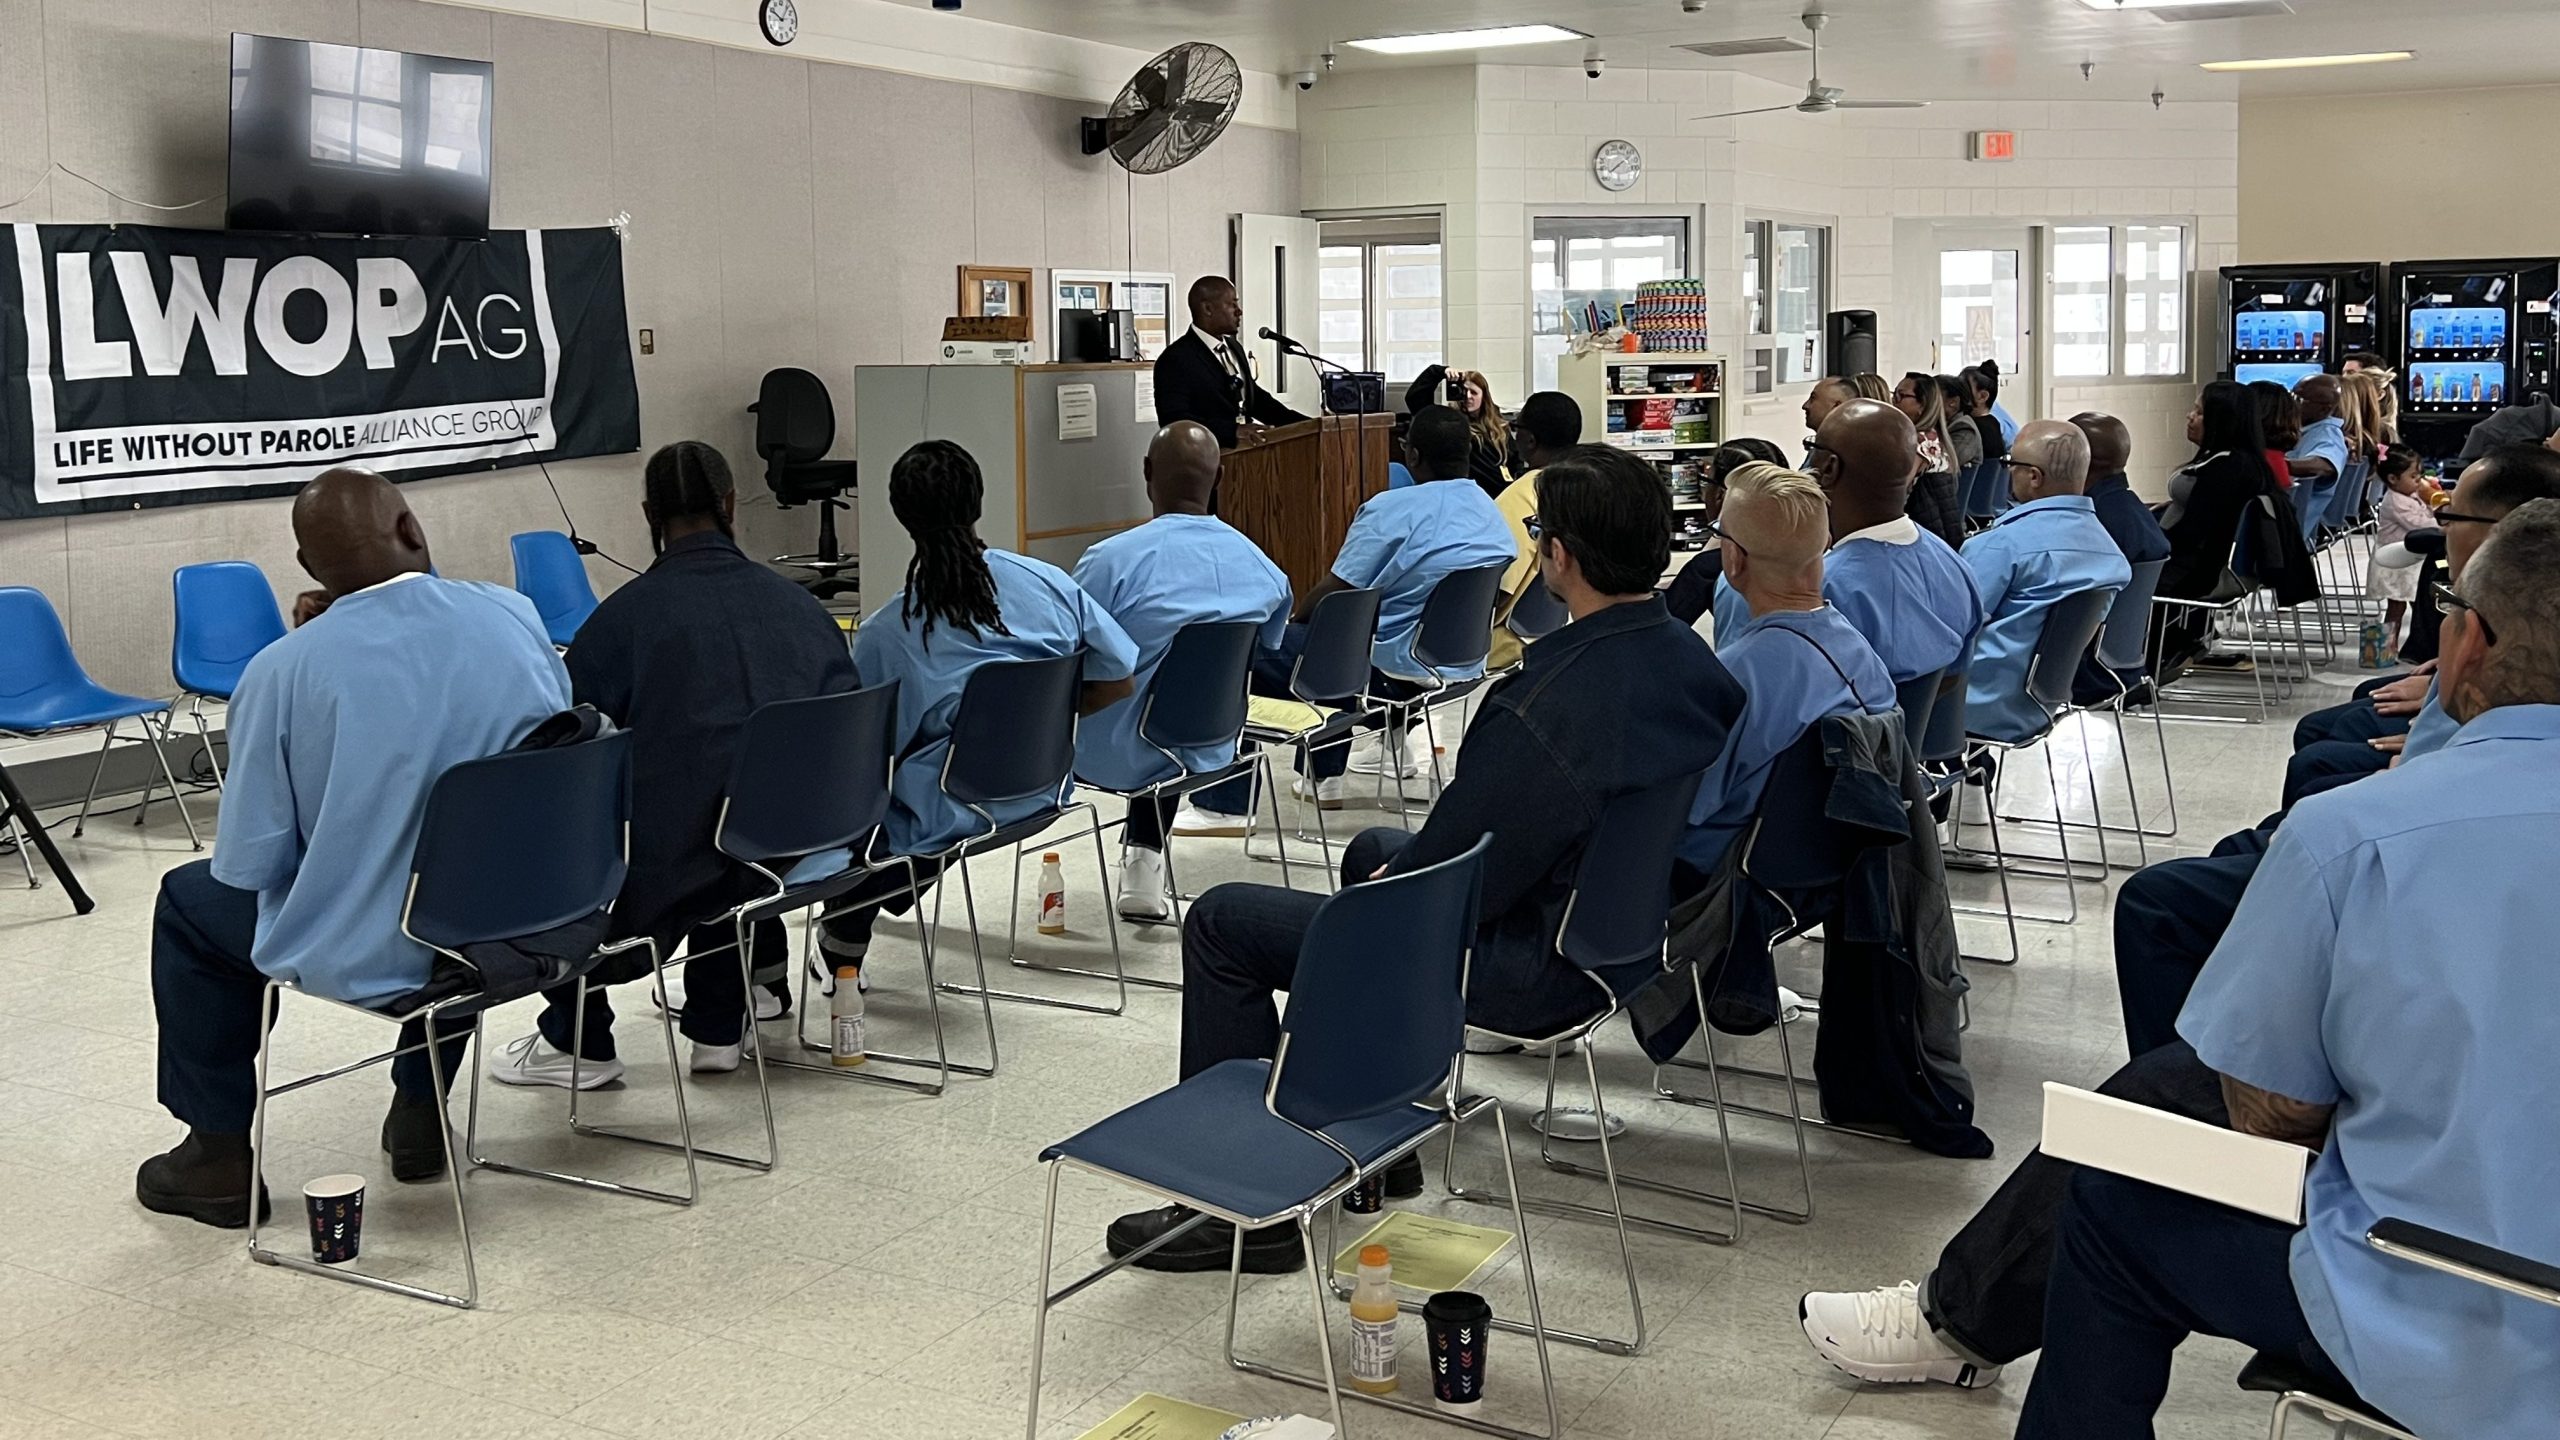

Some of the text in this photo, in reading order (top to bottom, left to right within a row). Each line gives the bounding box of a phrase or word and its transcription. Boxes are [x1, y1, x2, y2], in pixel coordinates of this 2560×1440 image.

[1986, 133, 2014, 157] EXIT
[57, 251, 527, 381] LWOP AG
[54, 406, 543, 468] LIFE WITHOUT PAROLE ALLIANCE GROUP
